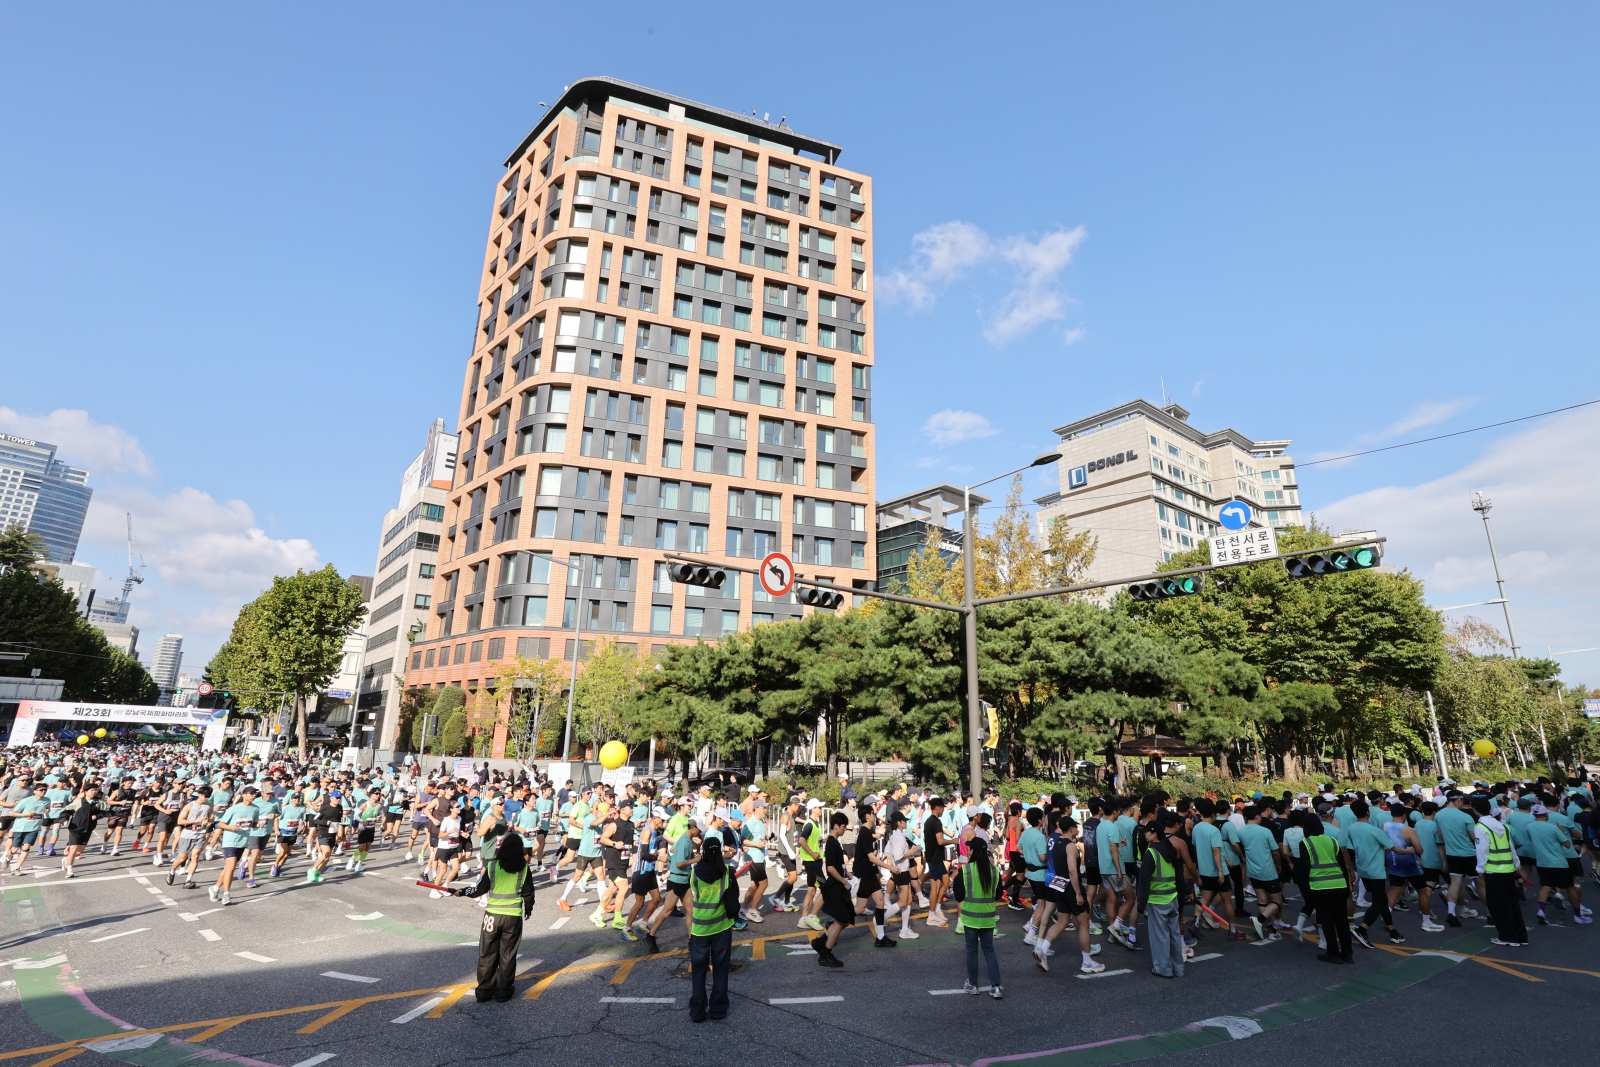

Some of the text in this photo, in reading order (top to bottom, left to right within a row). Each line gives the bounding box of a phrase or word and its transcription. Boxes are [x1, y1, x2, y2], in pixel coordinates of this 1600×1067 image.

[7, 435, 36, 447] TOWER
[1215, 531, 1270, 550] 탄천서로
[1216, 543, 1272, 562] 전용도로
[72, 707, 111, 717] 제23회
[483, 914, 495, 932] 98
